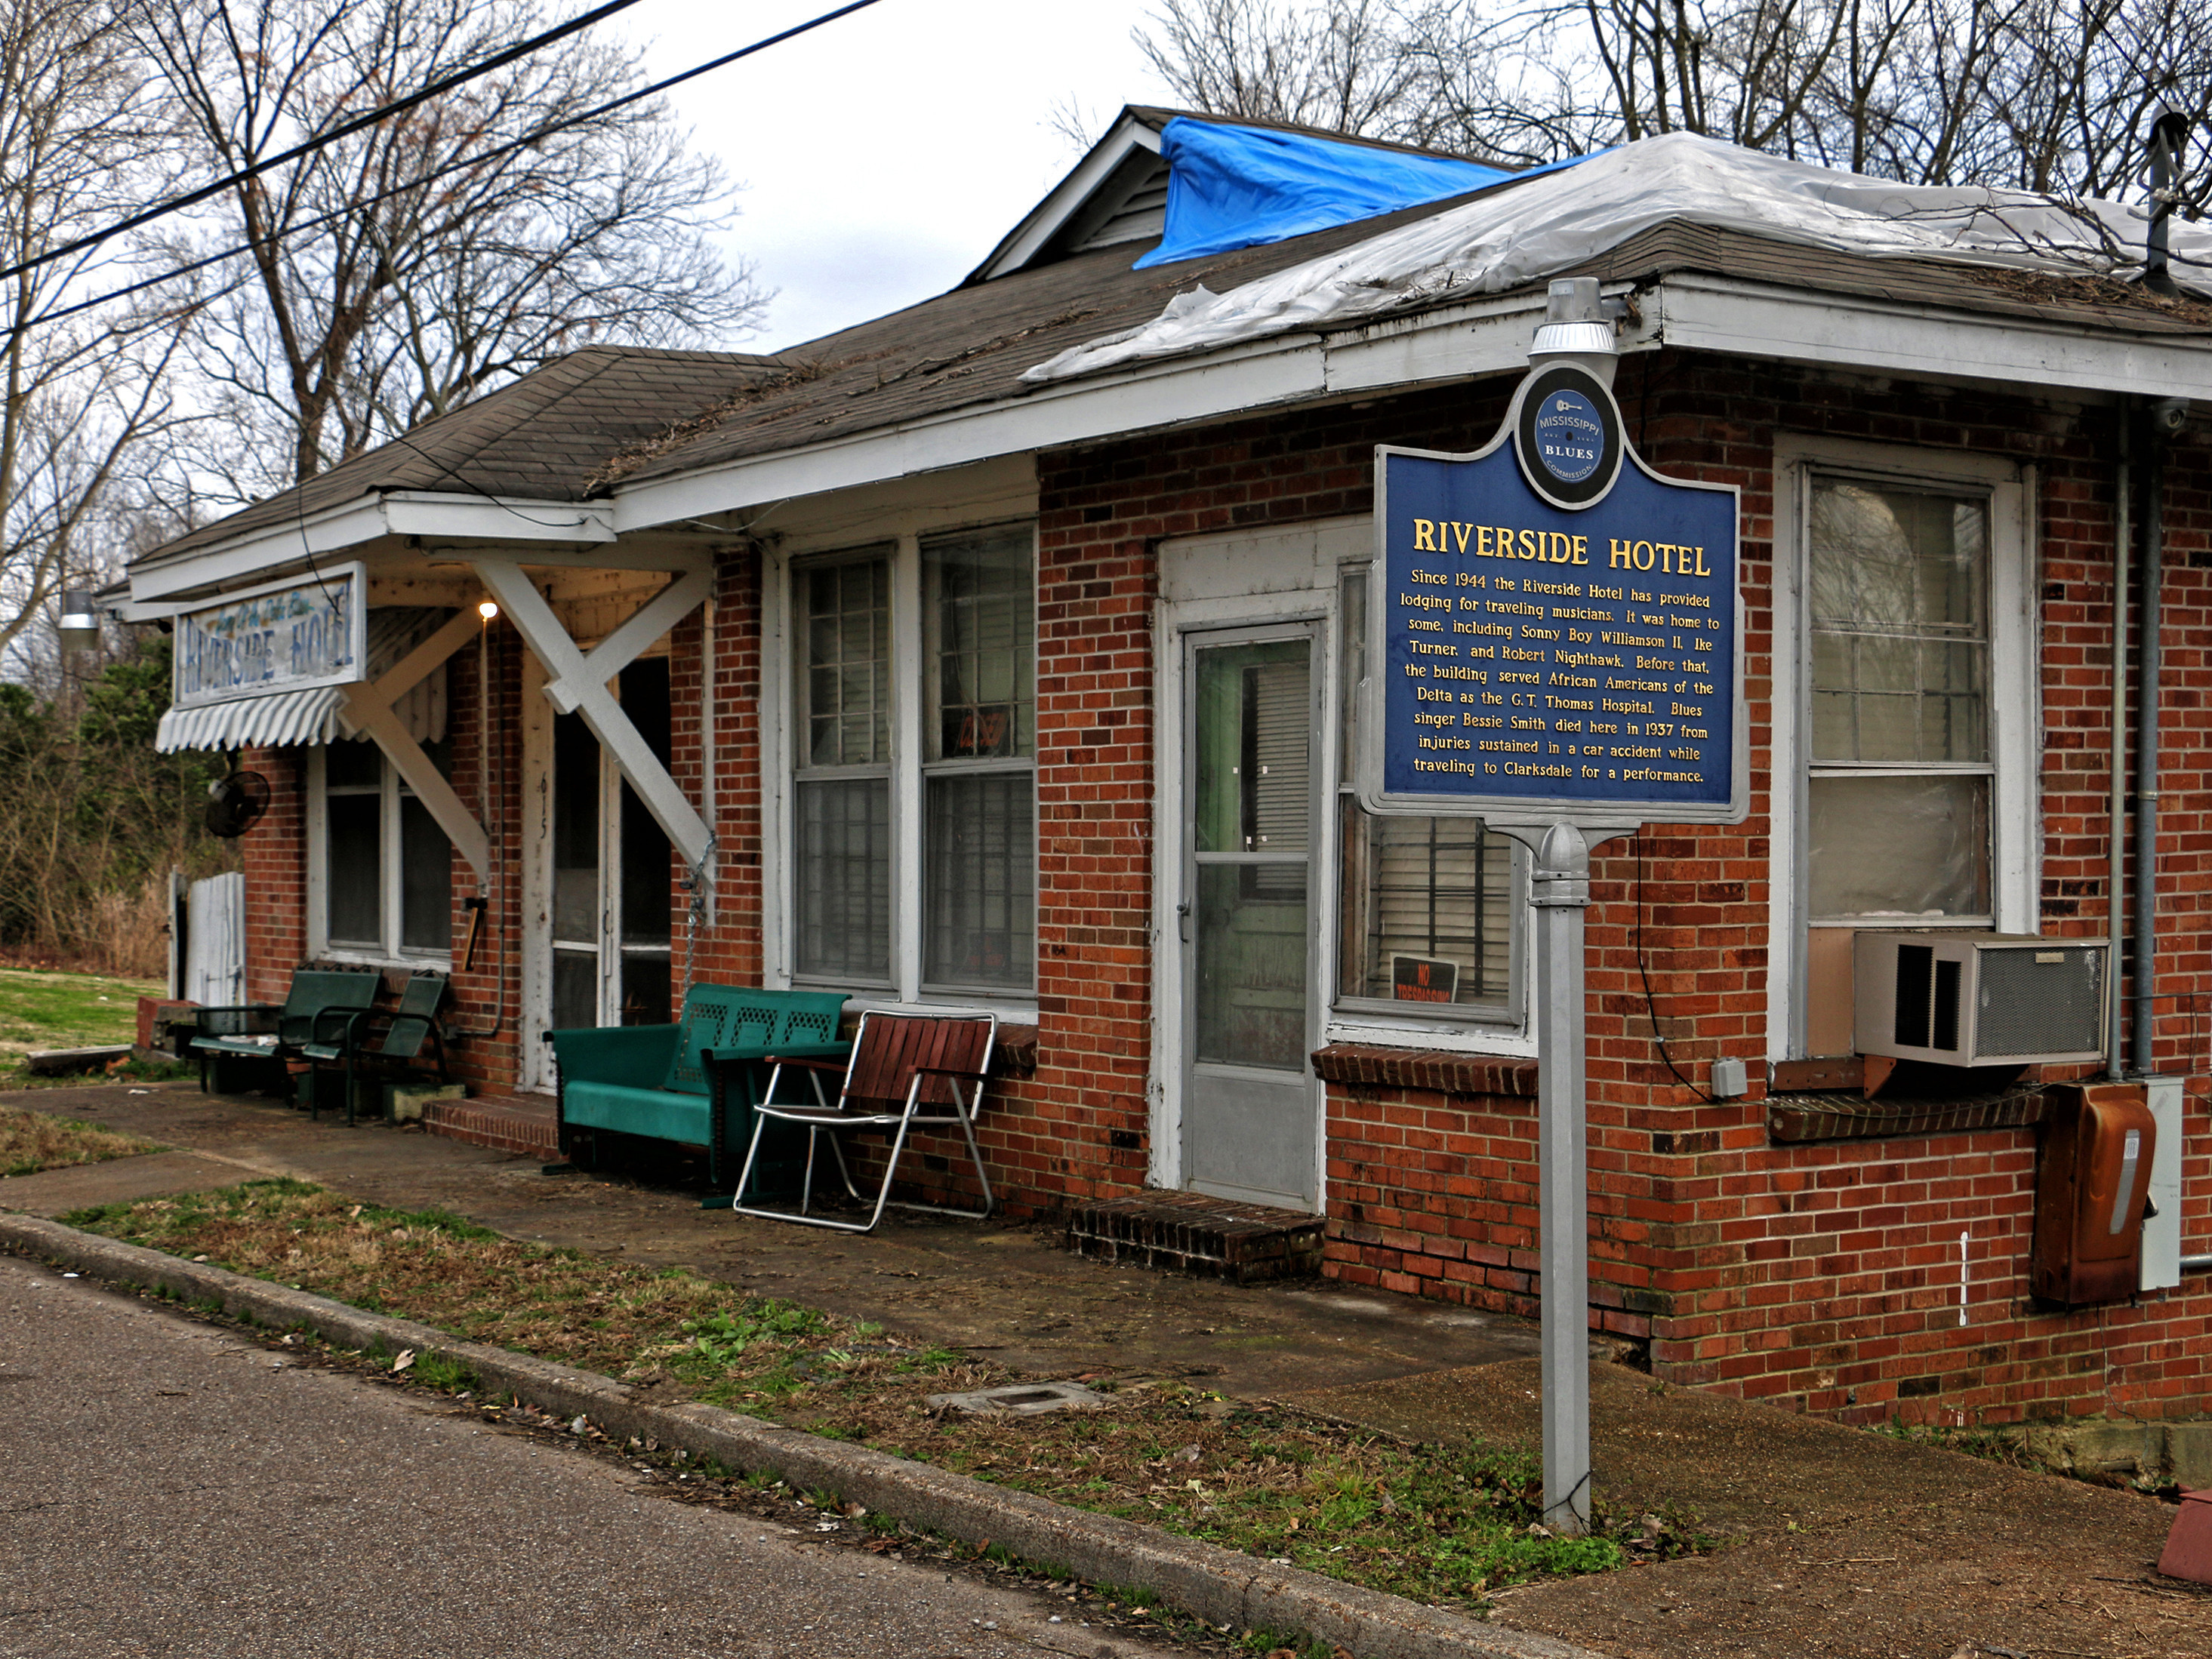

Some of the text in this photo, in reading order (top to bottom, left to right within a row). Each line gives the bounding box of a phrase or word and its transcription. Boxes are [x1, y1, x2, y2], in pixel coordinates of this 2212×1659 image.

[1539, 416, 1599, 436] MISSISSIPPI
[1545, 445, 1594, 460] BLUES
[1547, 460, 1592, 479] COMMISSION
[1413, 519, 1711, 577] RIVERSIDE HOTEL
[1411, 569, 1710, 608] Since 1944 the Riverside Hotel has provided
[1400, 592, 1720, 629] lodging for traveling musicians. It was home to
[1453, 620, 1513, 640] including
[1520, 624, 1560, 642] Sonny
[1568, 627, 1593, 644] Boy
[1600, 631, 1665, 648] Williamson
[1672, 636, 1684, 650] II,
[1694, 637, 1712, 651] Ike
[1470, 645, 1495, 659] and
[1502, 645, 1545, 662] Robert
[1554, 649, 1625, 668] Nighthawk.
[1636, 655, 1675, 671] Before
[1681, 659, 1709, 674] that,
[1404, 663, 1714, 694] the building served African Americans of the
[1417, 686, 1453, 702] Delta
[1460, 693, 1474, 703] as
[1480, 691, 1503, 705] the
[1545, 695, 1594, 710] Thomas
[1602, 697, 1655, 715] Hospital.
[1671, 702, 1702, 717] Blues
[1414, 712, 1708, 739] singer Bessie Smith died here in 1937 from
[1419, 734, 1700, 760] injuries sustained in a car accident while
[1413, 758, 1704, 782] traveling to Clarksdale for a performance.
[1418, 963, 1430, 986] NO
